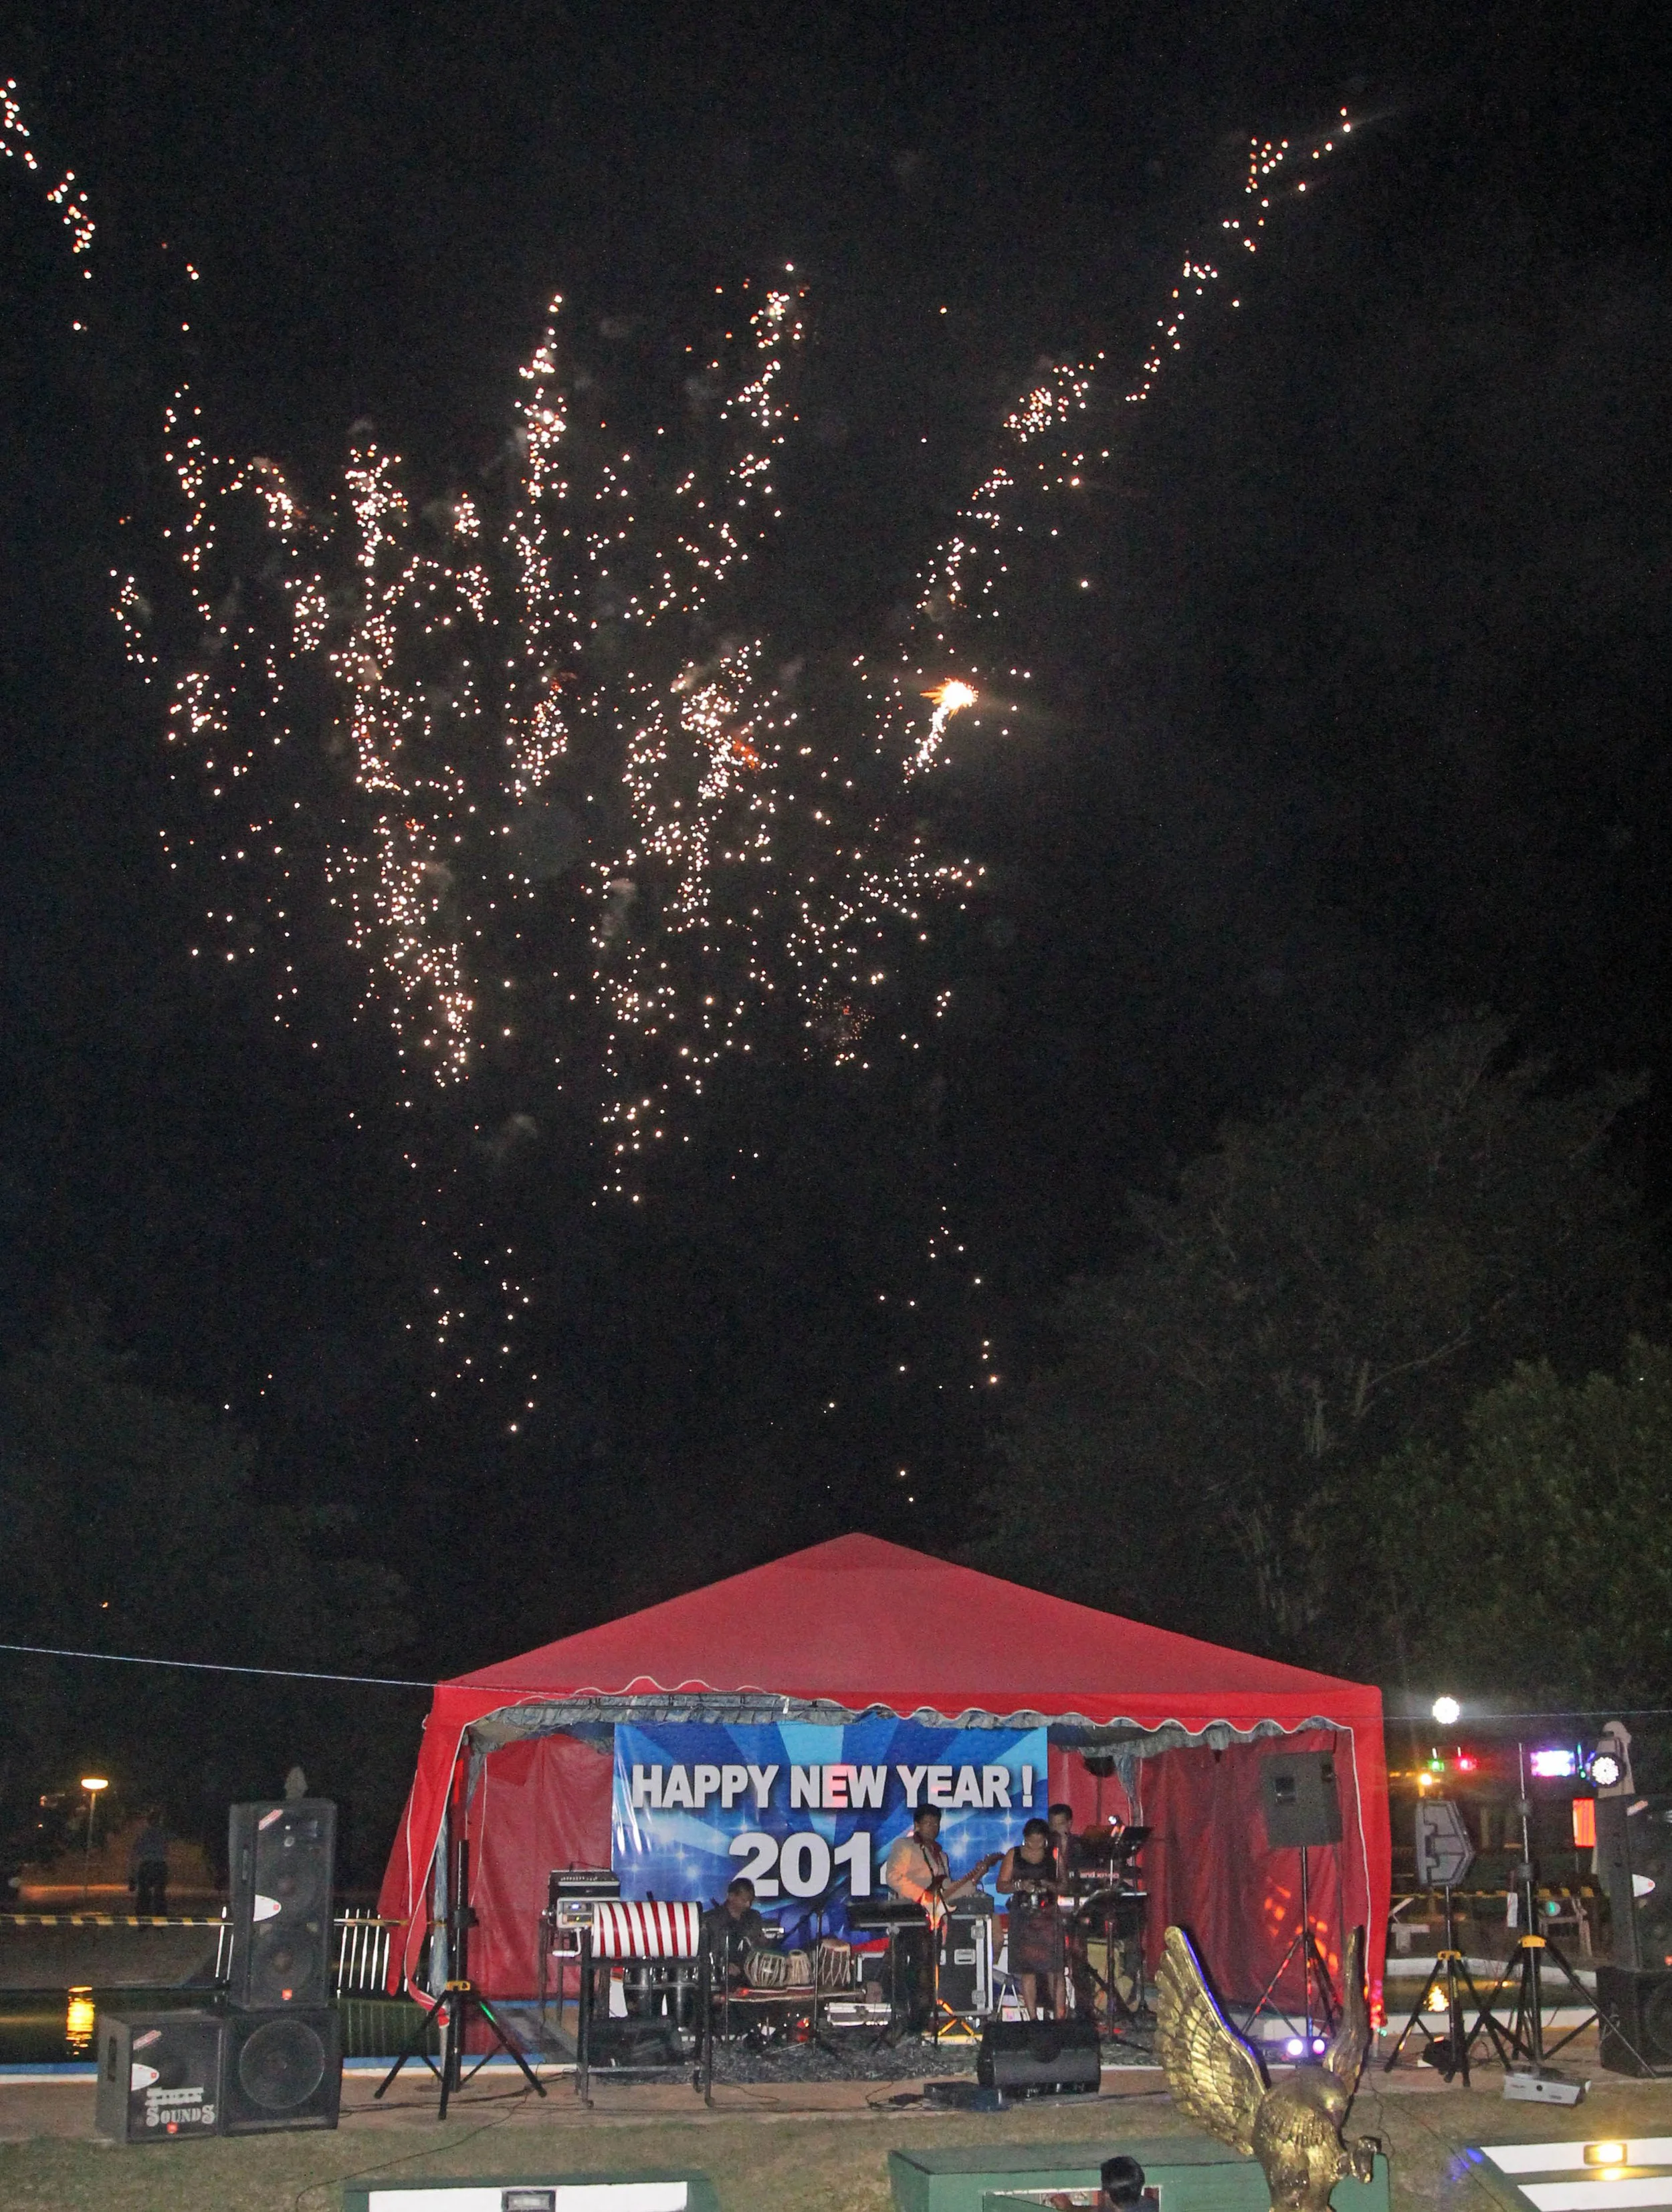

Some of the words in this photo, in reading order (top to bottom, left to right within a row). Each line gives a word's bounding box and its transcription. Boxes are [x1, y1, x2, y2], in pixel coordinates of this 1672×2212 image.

[632, 1764, 779, 1808] HAPPY
[791, 1763, 887, 1809] NEW
[728, 1831, 887, 1898] 201
